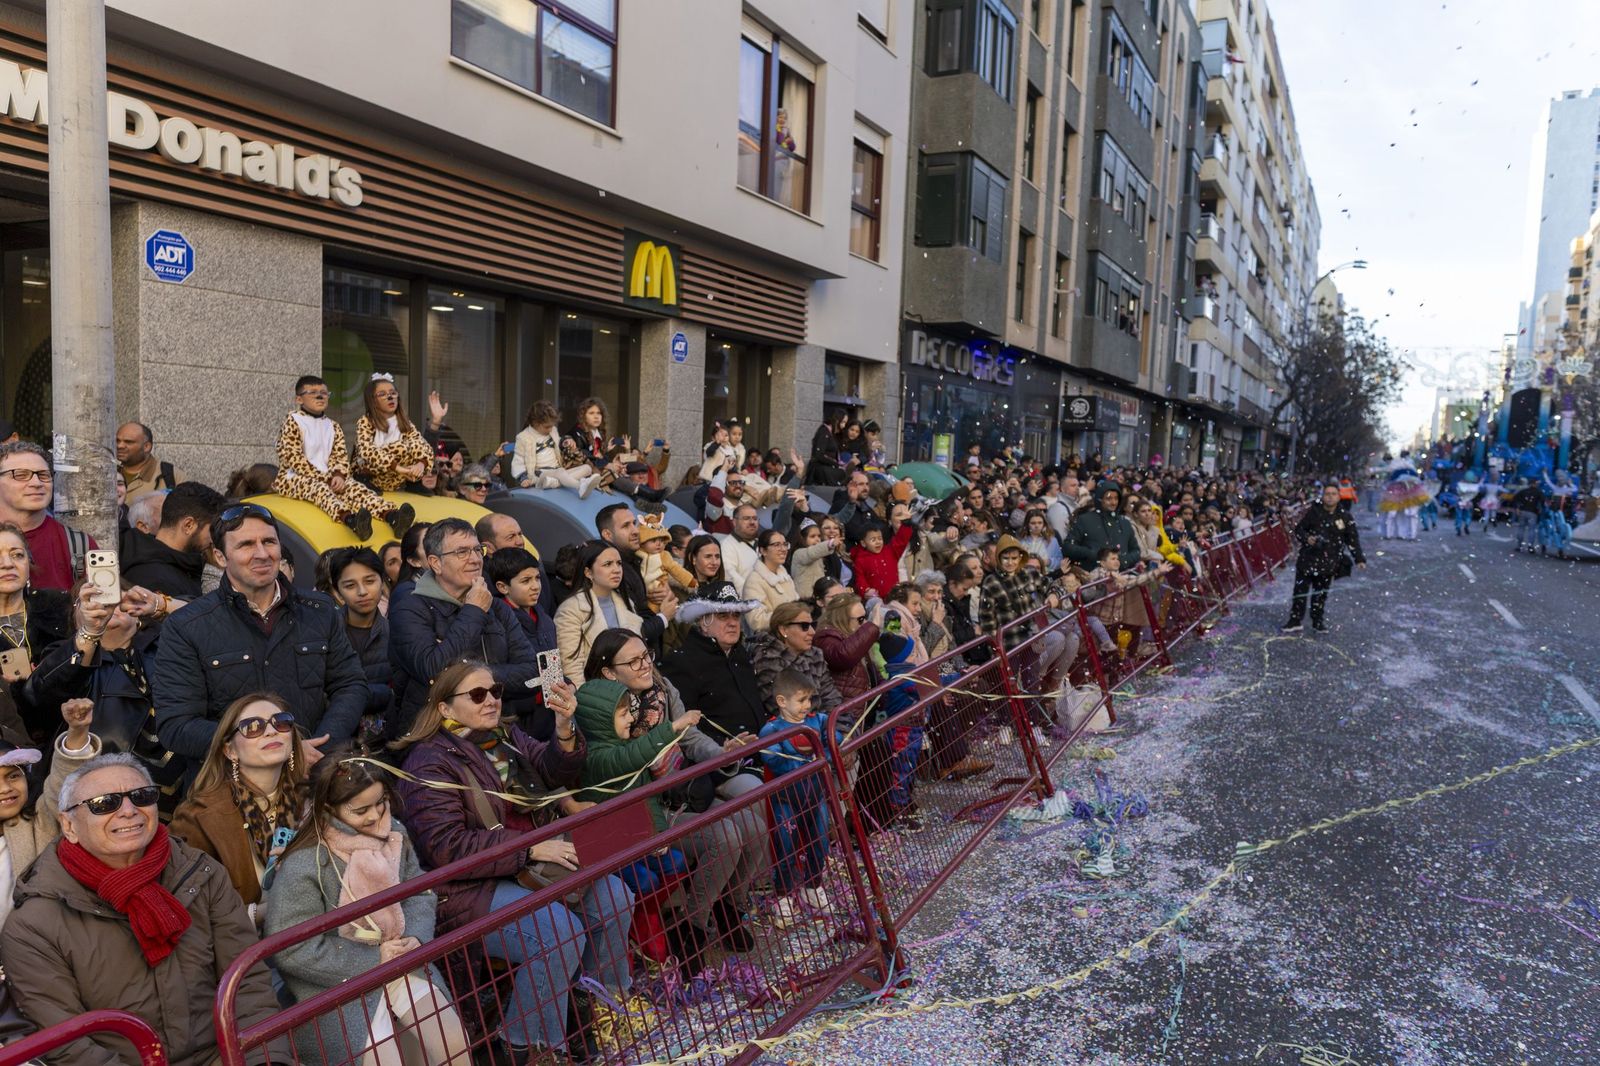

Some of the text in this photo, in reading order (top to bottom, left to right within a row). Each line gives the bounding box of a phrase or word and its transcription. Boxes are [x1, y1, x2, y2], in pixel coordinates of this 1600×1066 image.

[0, 58, 364, 208] MDonald's
[155, 245, 186, 264] ADT
[165, 266, 176, 274] 444
